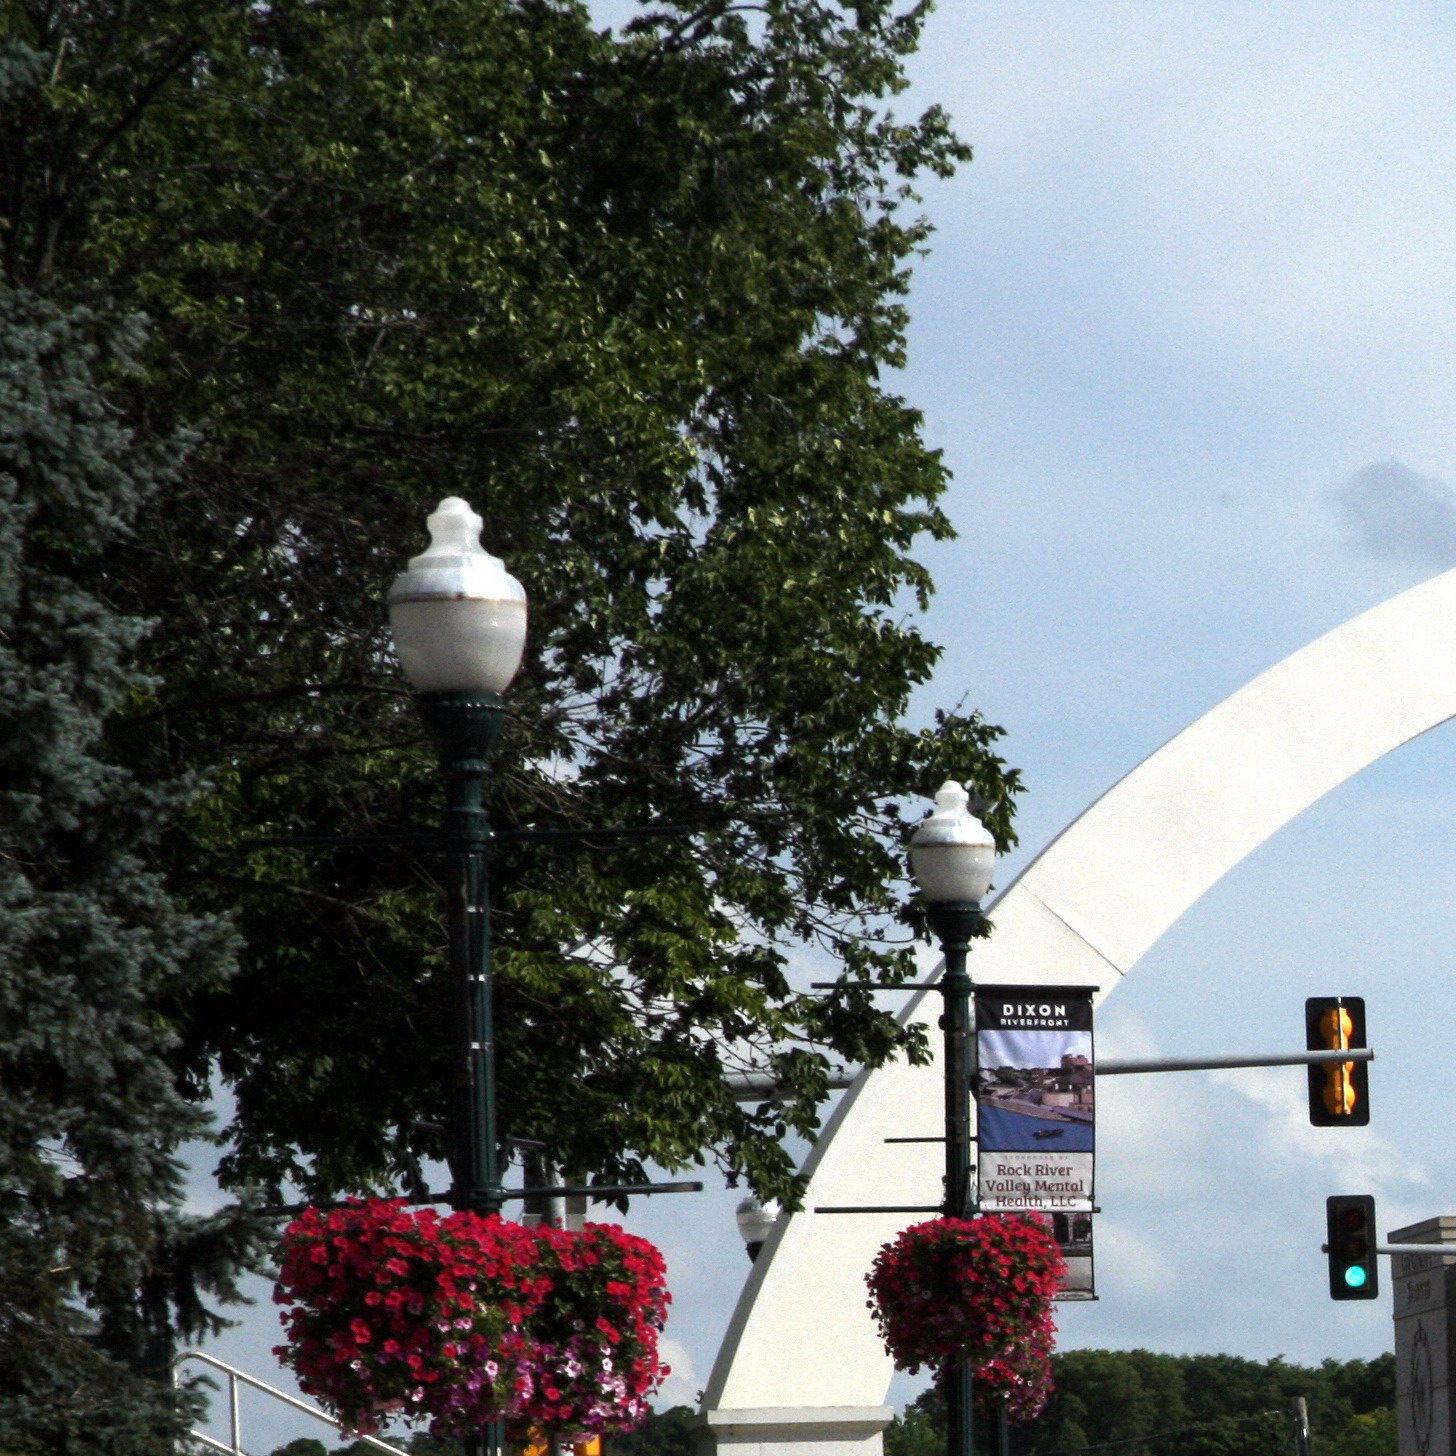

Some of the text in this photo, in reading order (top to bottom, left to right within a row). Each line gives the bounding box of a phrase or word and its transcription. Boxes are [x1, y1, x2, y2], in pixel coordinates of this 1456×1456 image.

[1002, 1003, 1066, 1017] DIXON
[1000, 1018, 1069, 1027] RIVERFRONT
[996, 1163, 1073, 1176] Rock River
[985, 1179, 1084, 1194] Valley Mental
[996, 1195, 1077, 1209] Health, LLC
